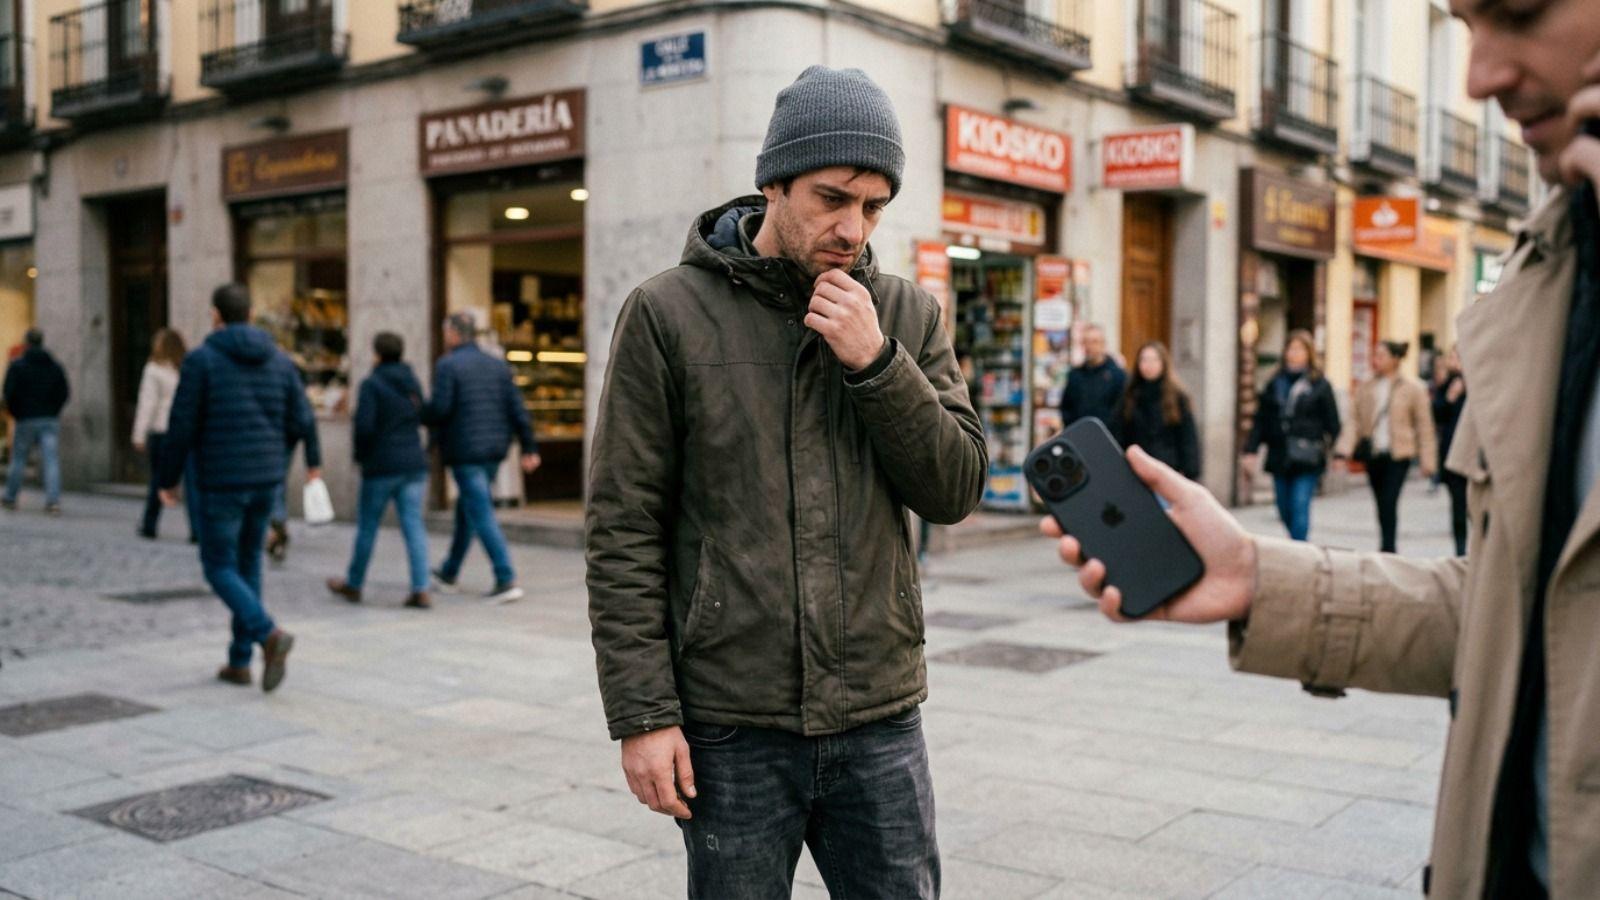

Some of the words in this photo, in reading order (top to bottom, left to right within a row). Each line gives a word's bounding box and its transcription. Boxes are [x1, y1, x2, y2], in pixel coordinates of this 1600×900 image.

[425, 94, 574, 149] PANADERÍA
[958, 110, 1065, 170] KIOSKO
[1104, 133, 1180, 164] KIOSKO
